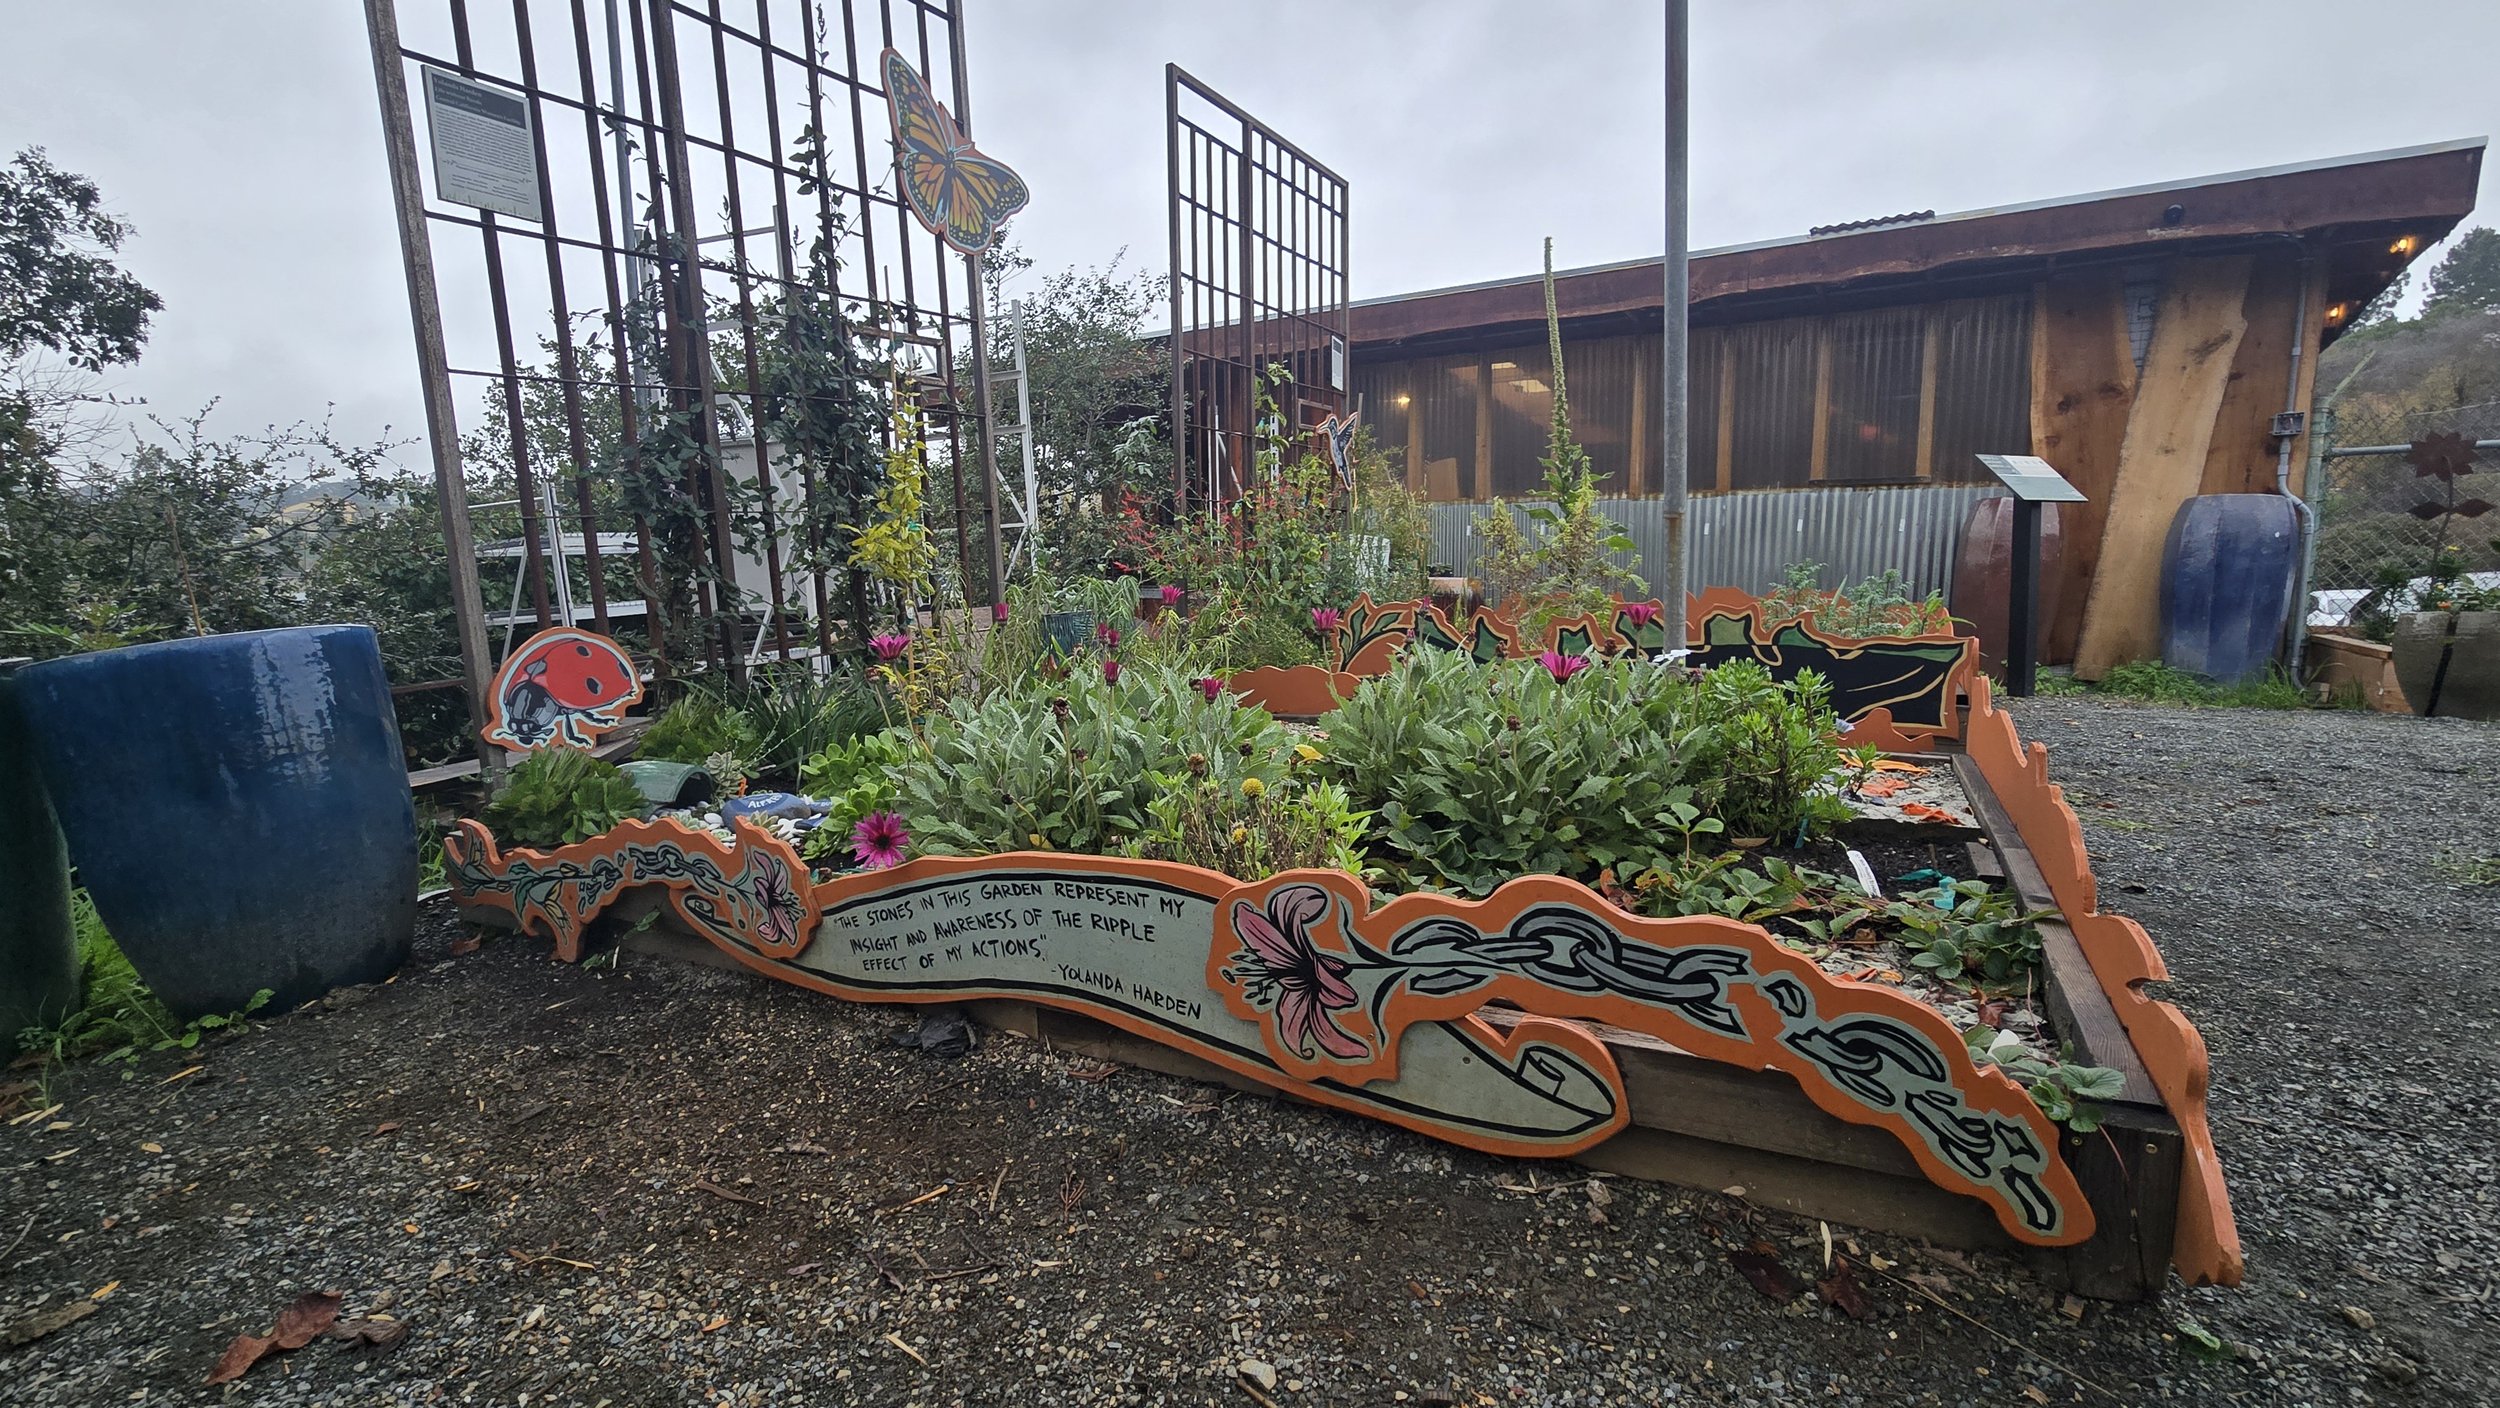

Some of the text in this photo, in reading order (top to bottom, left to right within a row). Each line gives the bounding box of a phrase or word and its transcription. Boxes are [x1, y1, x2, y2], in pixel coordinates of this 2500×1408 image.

[866, 900, 914, 926] STONES
[920, 894, 934, 912] IN
[937, 889, 971, 909] THIS
[980, 883, 1042, 900] GARDEN
[1054, 882, 1150, 908] REPRESENT
[1159, 897, 1185, 918] MY
[850, 908, 1156, 955] INSIGHT AND AWARENESS OF THE RIPPLE
[862, 956, 908, 971] EFFECT
[918, 953, 935, 970] OF
[946, 944, 962, 962] MY
[1133, 984, 1202, 1020] HARDEN
